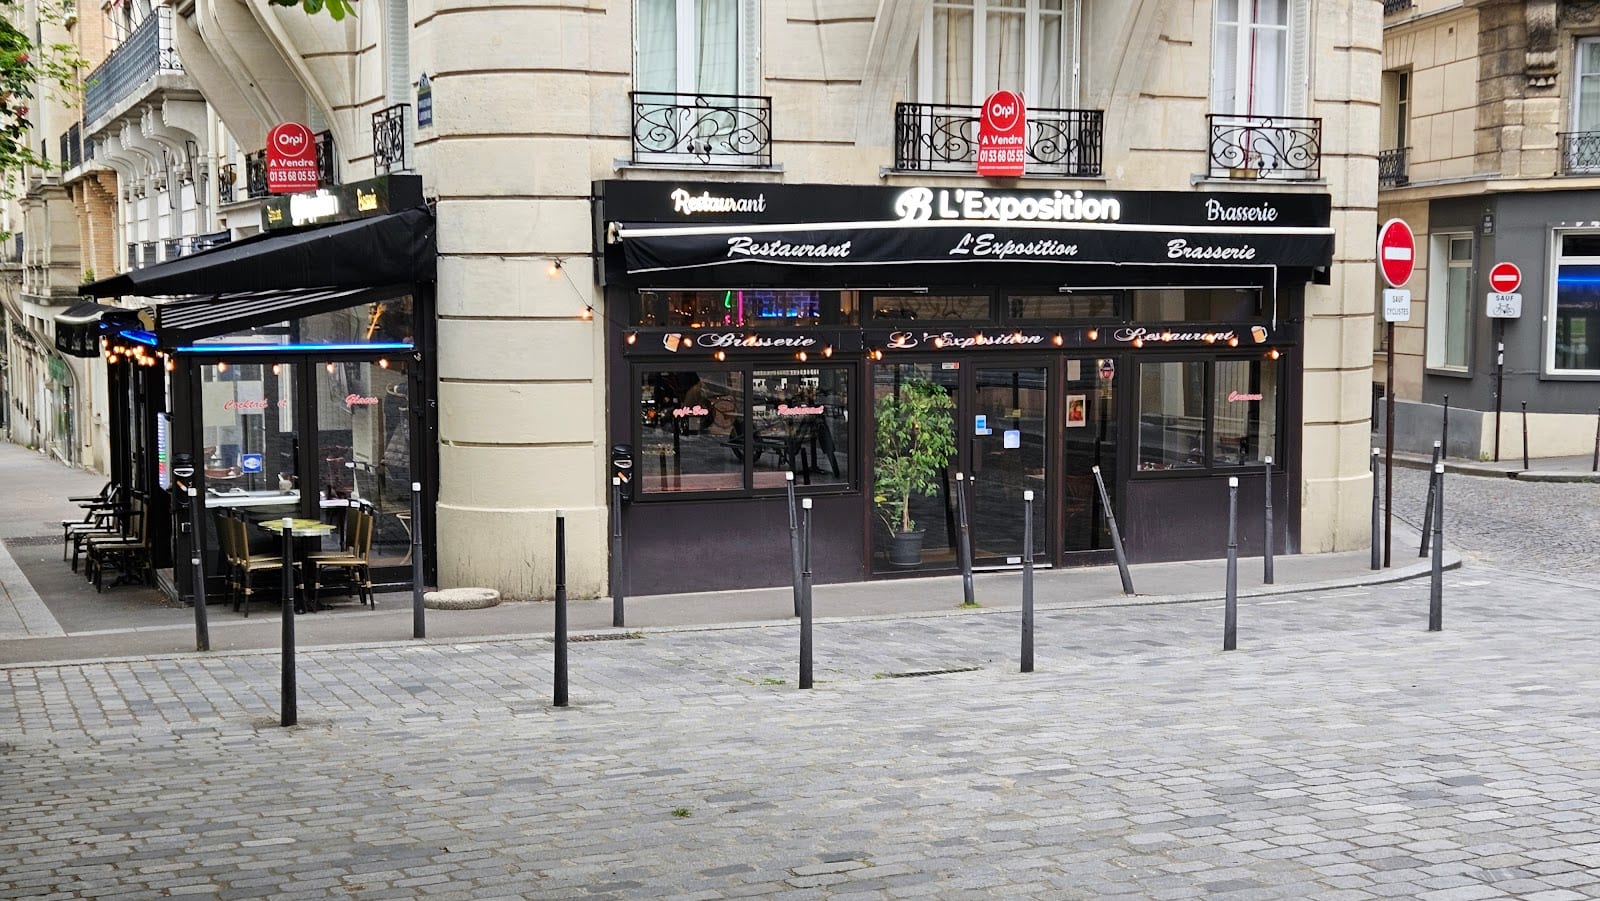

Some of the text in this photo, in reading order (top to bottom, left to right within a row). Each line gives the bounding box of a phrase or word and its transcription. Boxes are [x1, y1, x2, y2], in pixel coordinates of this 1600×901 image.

[992, 102, 1014, 118] Orpi
[279, 133, 303, 146] Orpi
[982, 134, 1023, 145] A Vendre
[269, 158, 314, 167] A Vendre
[980, 149, 1024, 162] 01 53 68 05 55
[269, 170, 316, 182] 01 53 68 05 55
[671, 187, 767, 215] Restaurant
[939, 188, 1121, 222] L'Exposition
[1205, 198, 1278, 222] Brasserie
[727, 236, 851, 258] Restaurant
[949, 232, 1078, 259] L'Exposition
[1167, 238, 1256, 260] Brasserie
[1392, 295, 1404, 304] SAUF
[1386, 307, 1409, 316] CYCLISTES
[697, 333, 816, 348] Brasserie
[1113, 327, 1235, 343] Resaurant
